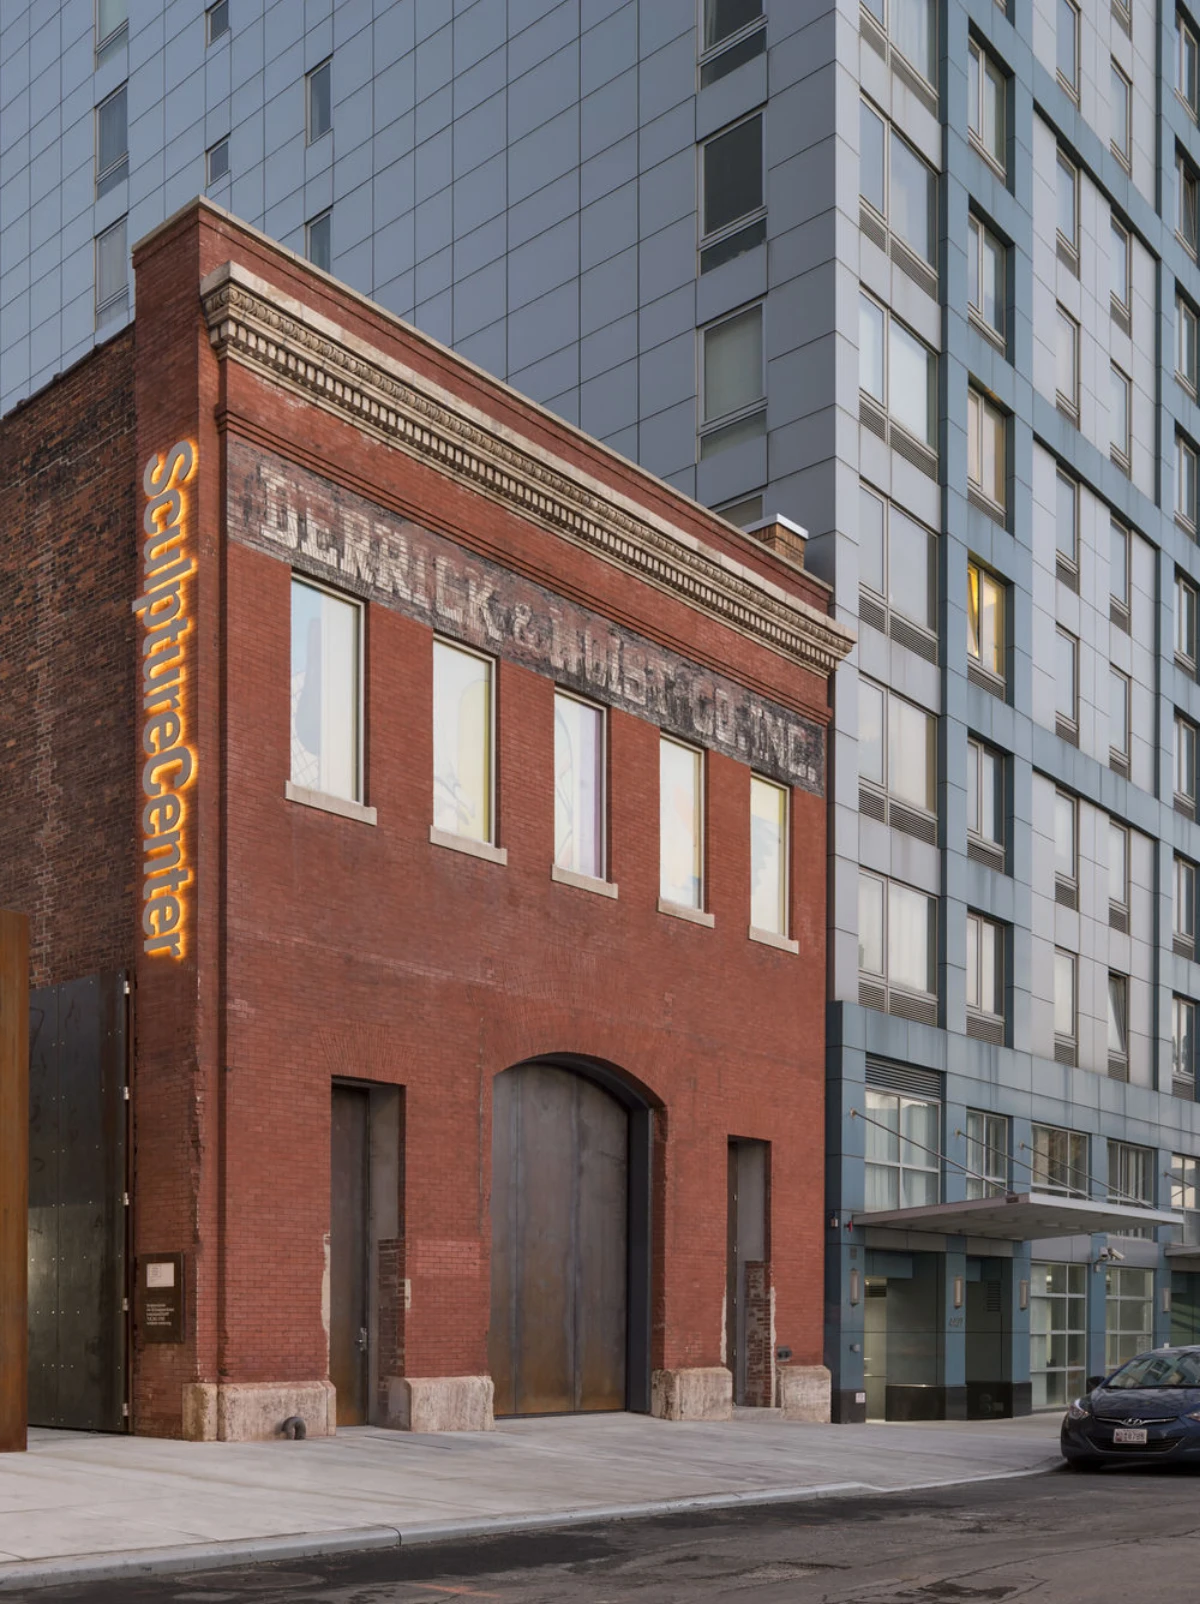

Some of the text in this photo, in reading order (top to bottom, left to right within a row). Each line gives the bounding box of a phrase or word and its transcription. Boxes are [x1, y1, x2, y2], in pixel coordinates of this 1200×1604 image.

[131, 440, 196, 959] SculptureCenter
[260, 465, 503, 642] DERRICK
[511, 602, 541, 650] &
